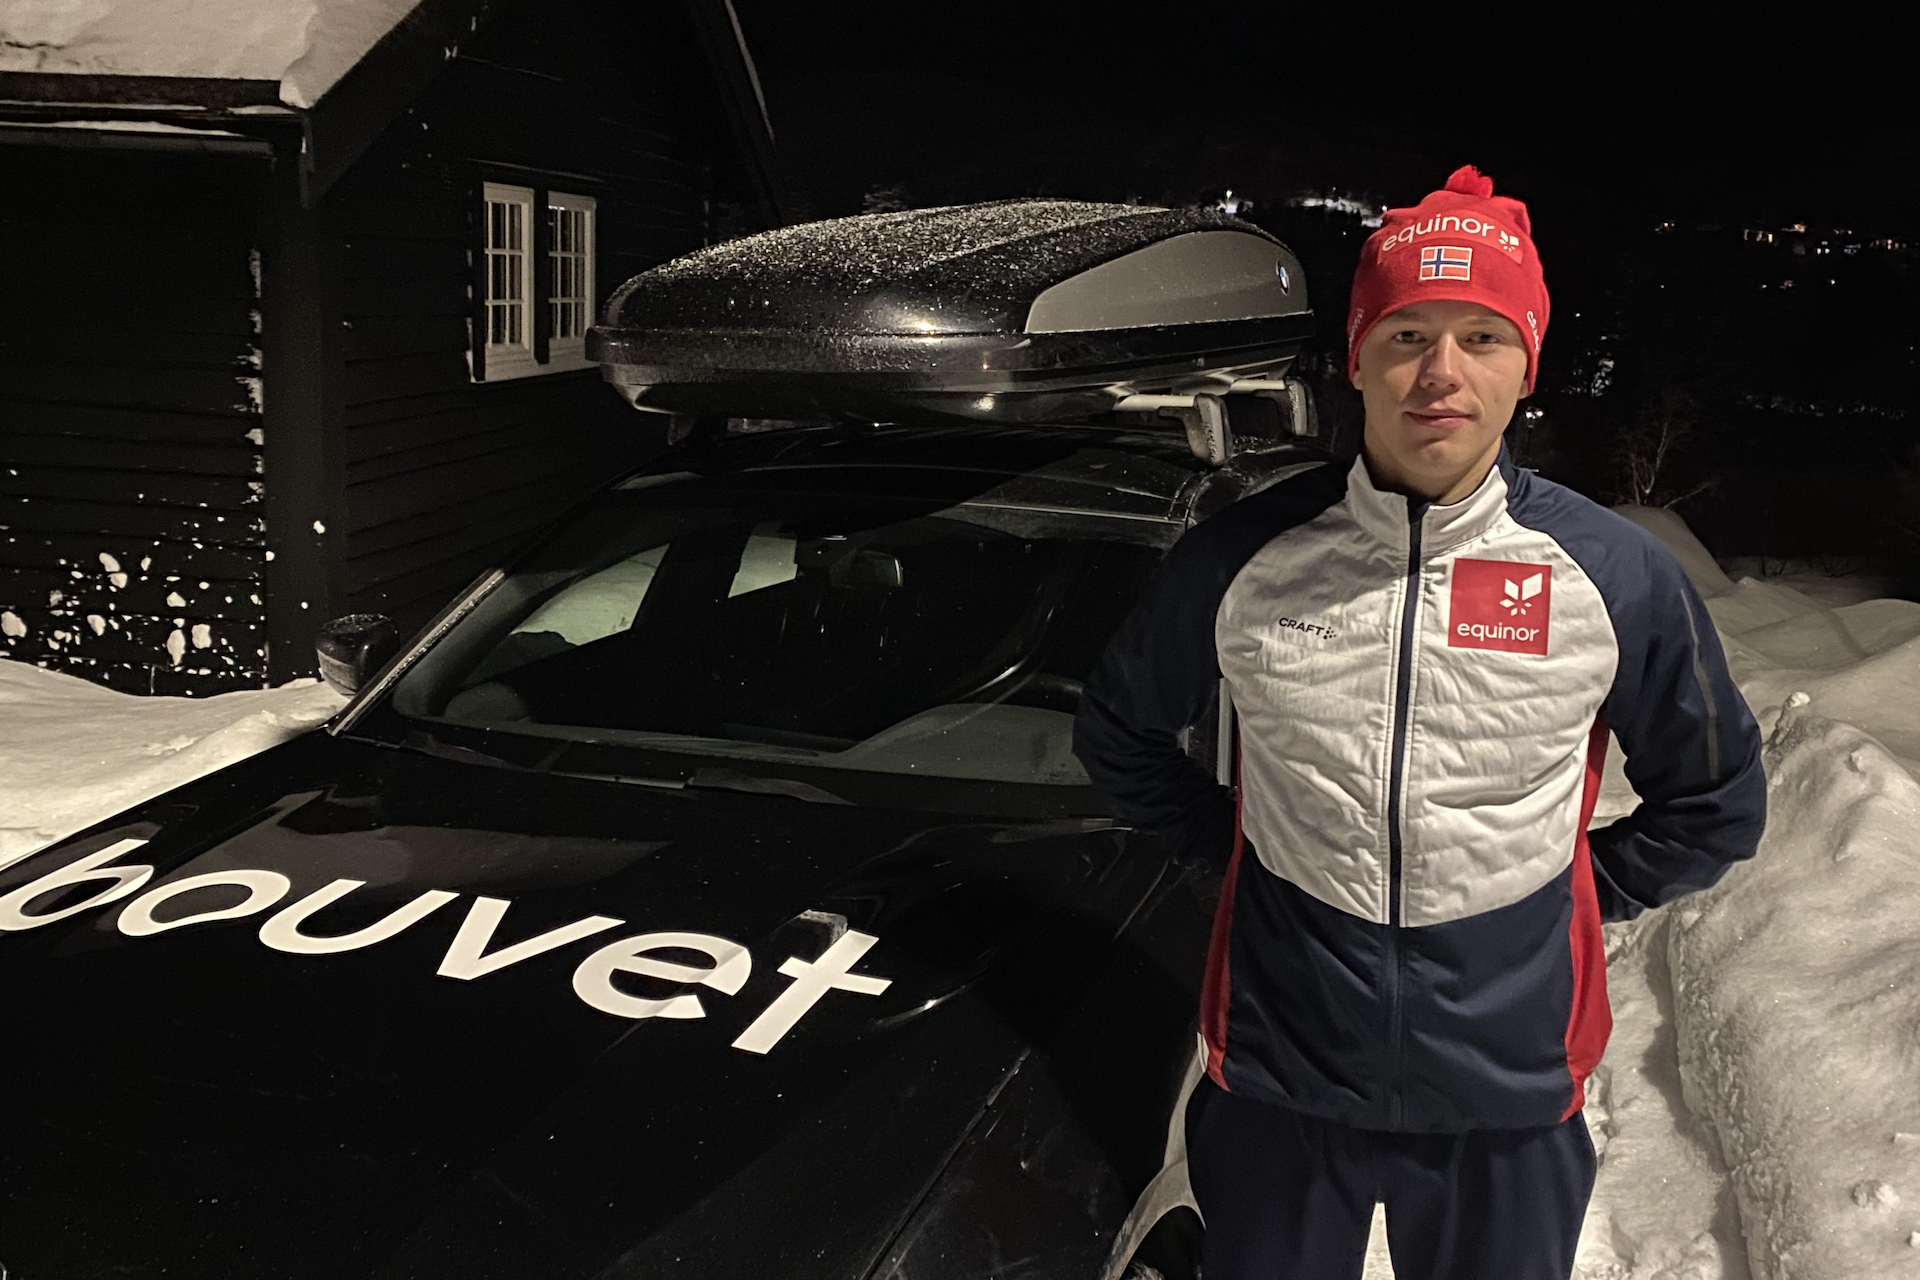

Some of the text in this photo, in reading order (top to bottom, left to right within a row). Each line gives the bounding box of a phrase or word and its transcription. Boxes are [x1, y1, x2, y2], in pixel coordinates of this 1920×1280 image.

[1382, 213, 1495, 251] equinor
[1279, 617, 1325, 637] CRAFT
[1457, 622, 1539, 643] equinor
[0, 838, 892, 1054] bouvet
